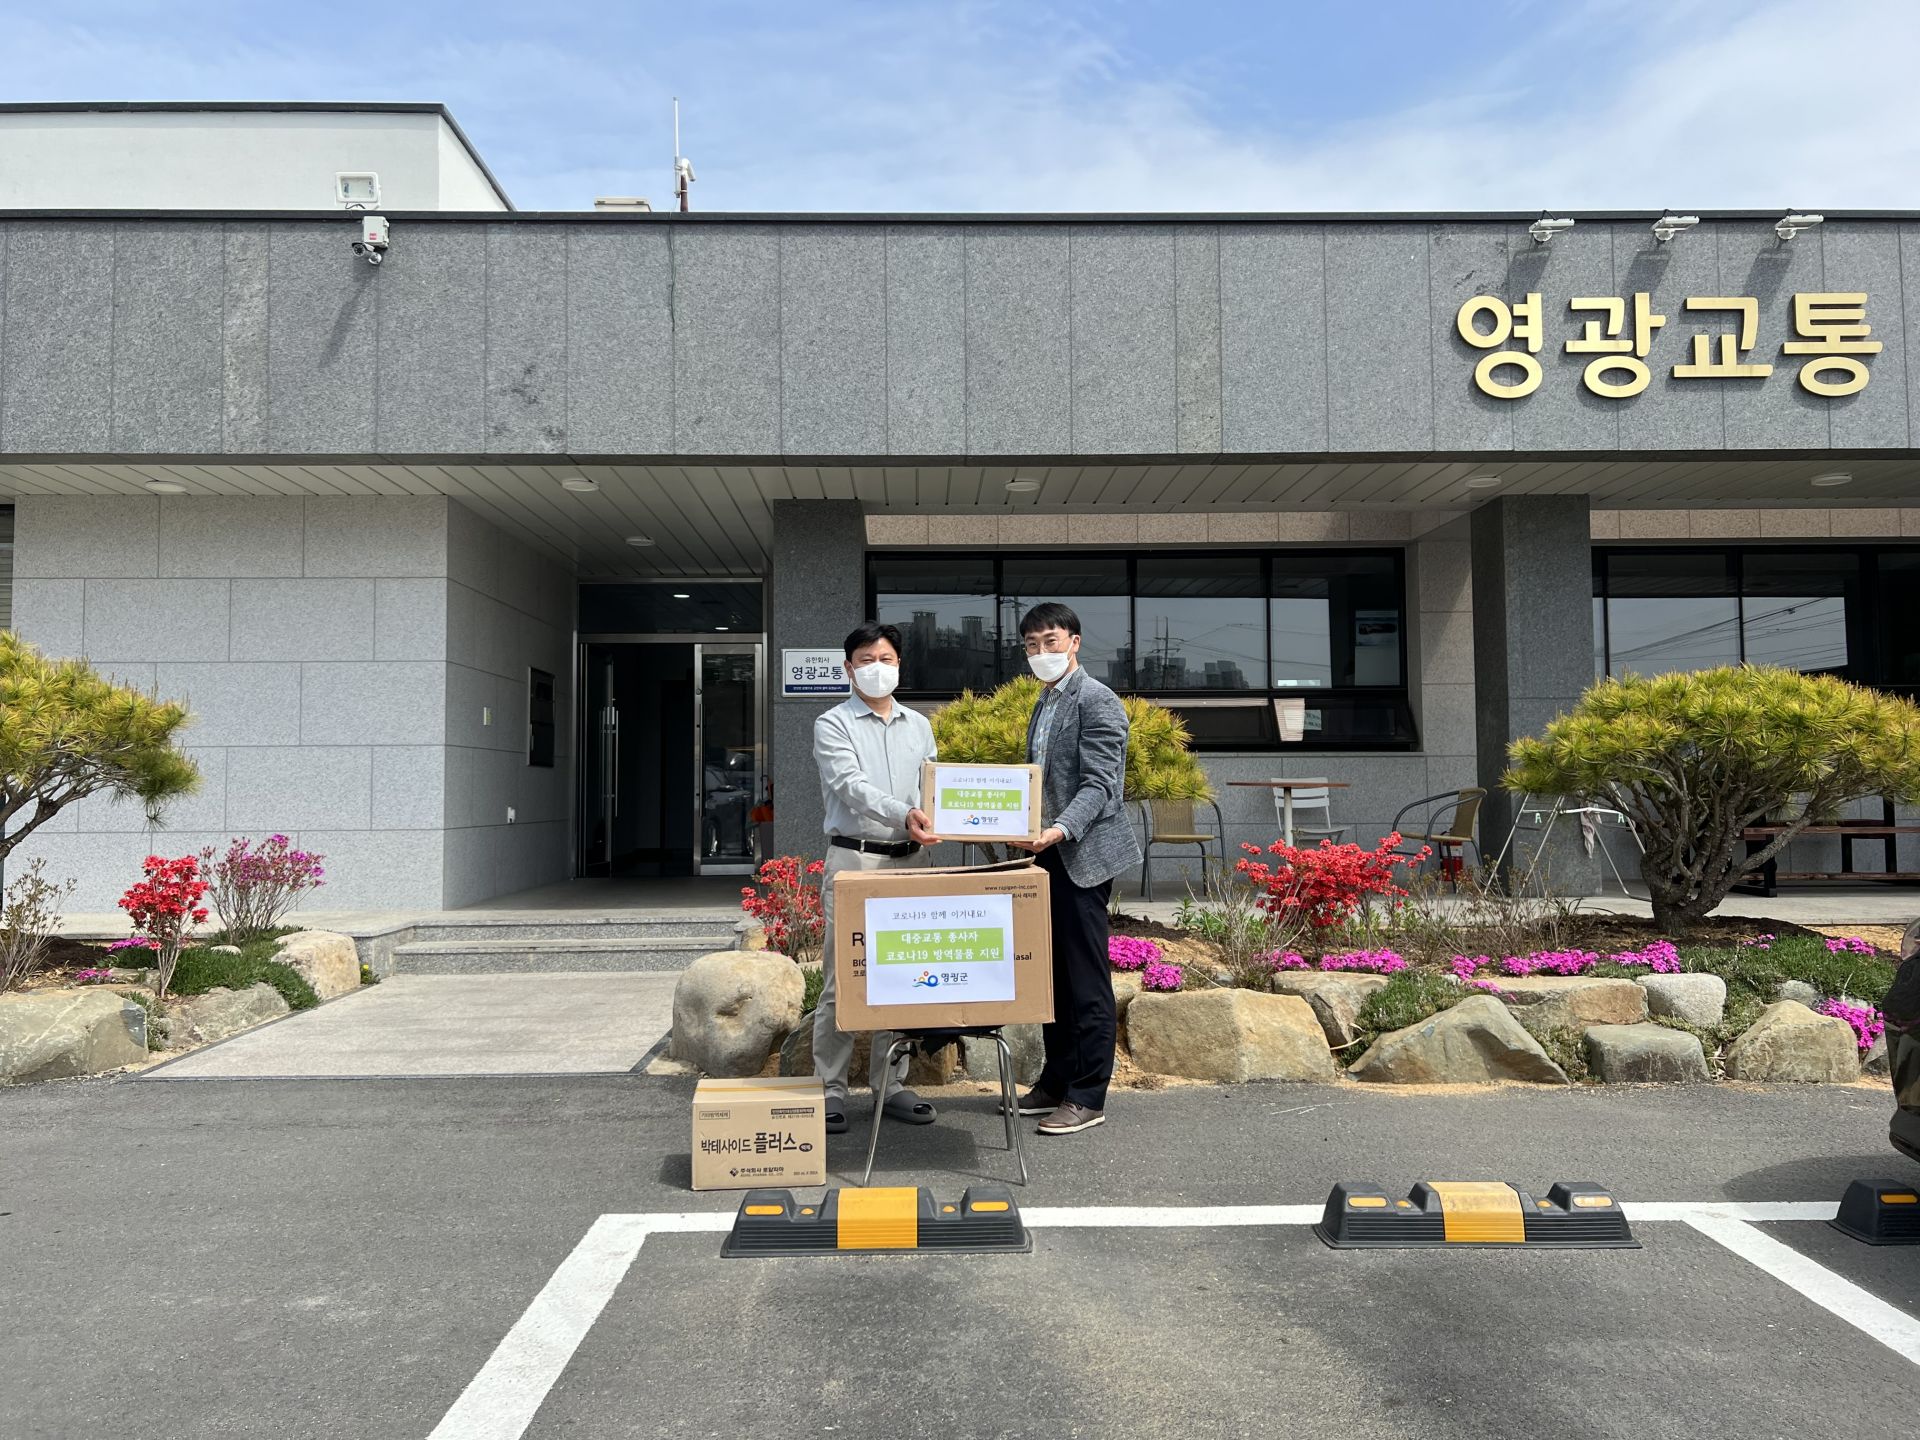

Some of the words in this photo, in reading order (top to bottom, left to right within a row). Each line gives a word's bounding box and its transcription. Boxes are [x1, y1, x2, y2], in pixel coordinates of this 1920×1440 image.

[1457, 292, 1883, 398] 영광교통
[805, 656, 830, 664] 유한회사
[791, 666, 844, 680] 영광교통
[892, 911, 927, 920] 코로나19
[930, 910, 947, 920] 함께
[901, 932, 942, 944] 대중교통
[948, 931, 978, 943] 종사자
[886, 950, 928, 961] 코로나19
[933, 948, 974, 960] 방역물품
[979, 947, 1000, 959] 지원
[1014, 952, 1032, 960] asal
[940, 972, 968, 983] 영광군
[701, 1137, 752, 1154] 박테사이드
[754, 1131, 797, 1154] 플러스
